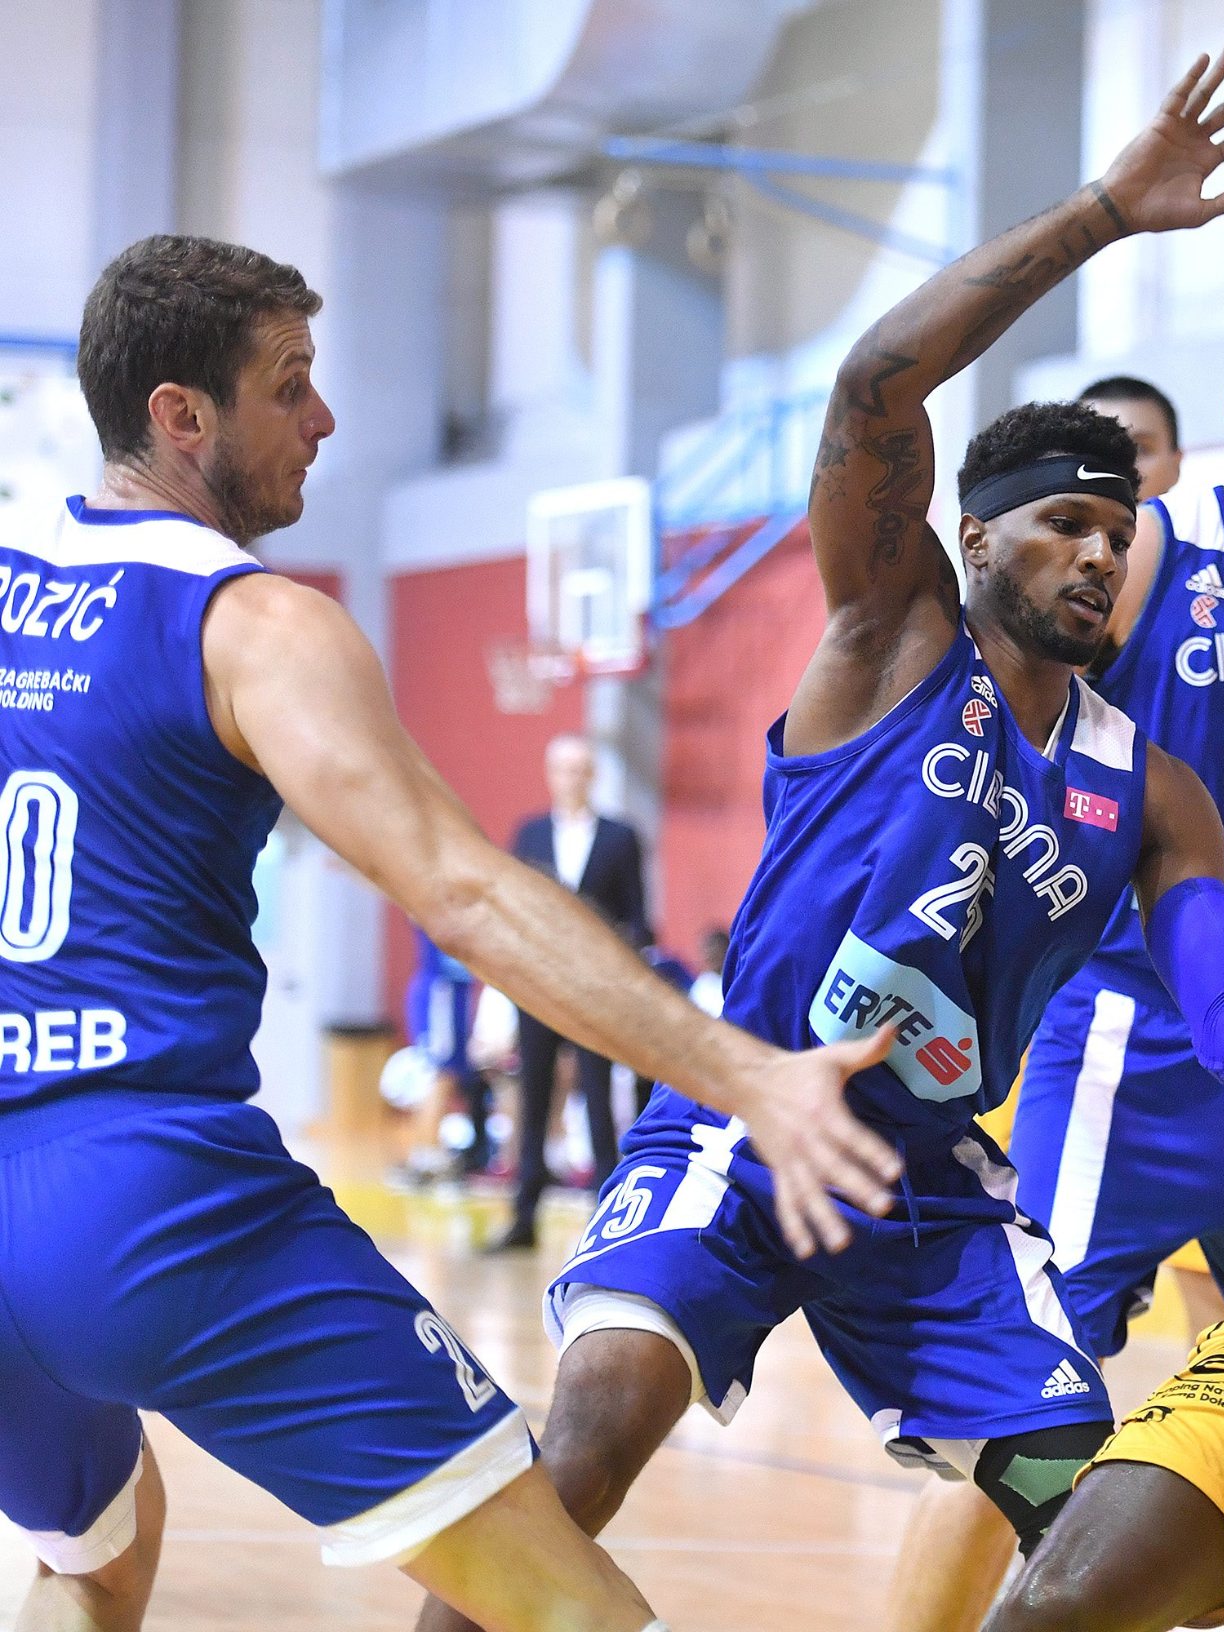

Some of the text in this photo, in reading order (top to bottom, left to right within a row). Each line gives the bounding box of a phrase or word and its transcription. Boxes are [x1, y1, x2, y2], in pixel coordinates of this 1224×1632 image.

[0, 689, 54, 711] OLDING
[0, 769, 79, 963] 0
[414, 1310, 497, 1414] 2
[1041, 1382, 1090, 1399] adidas
